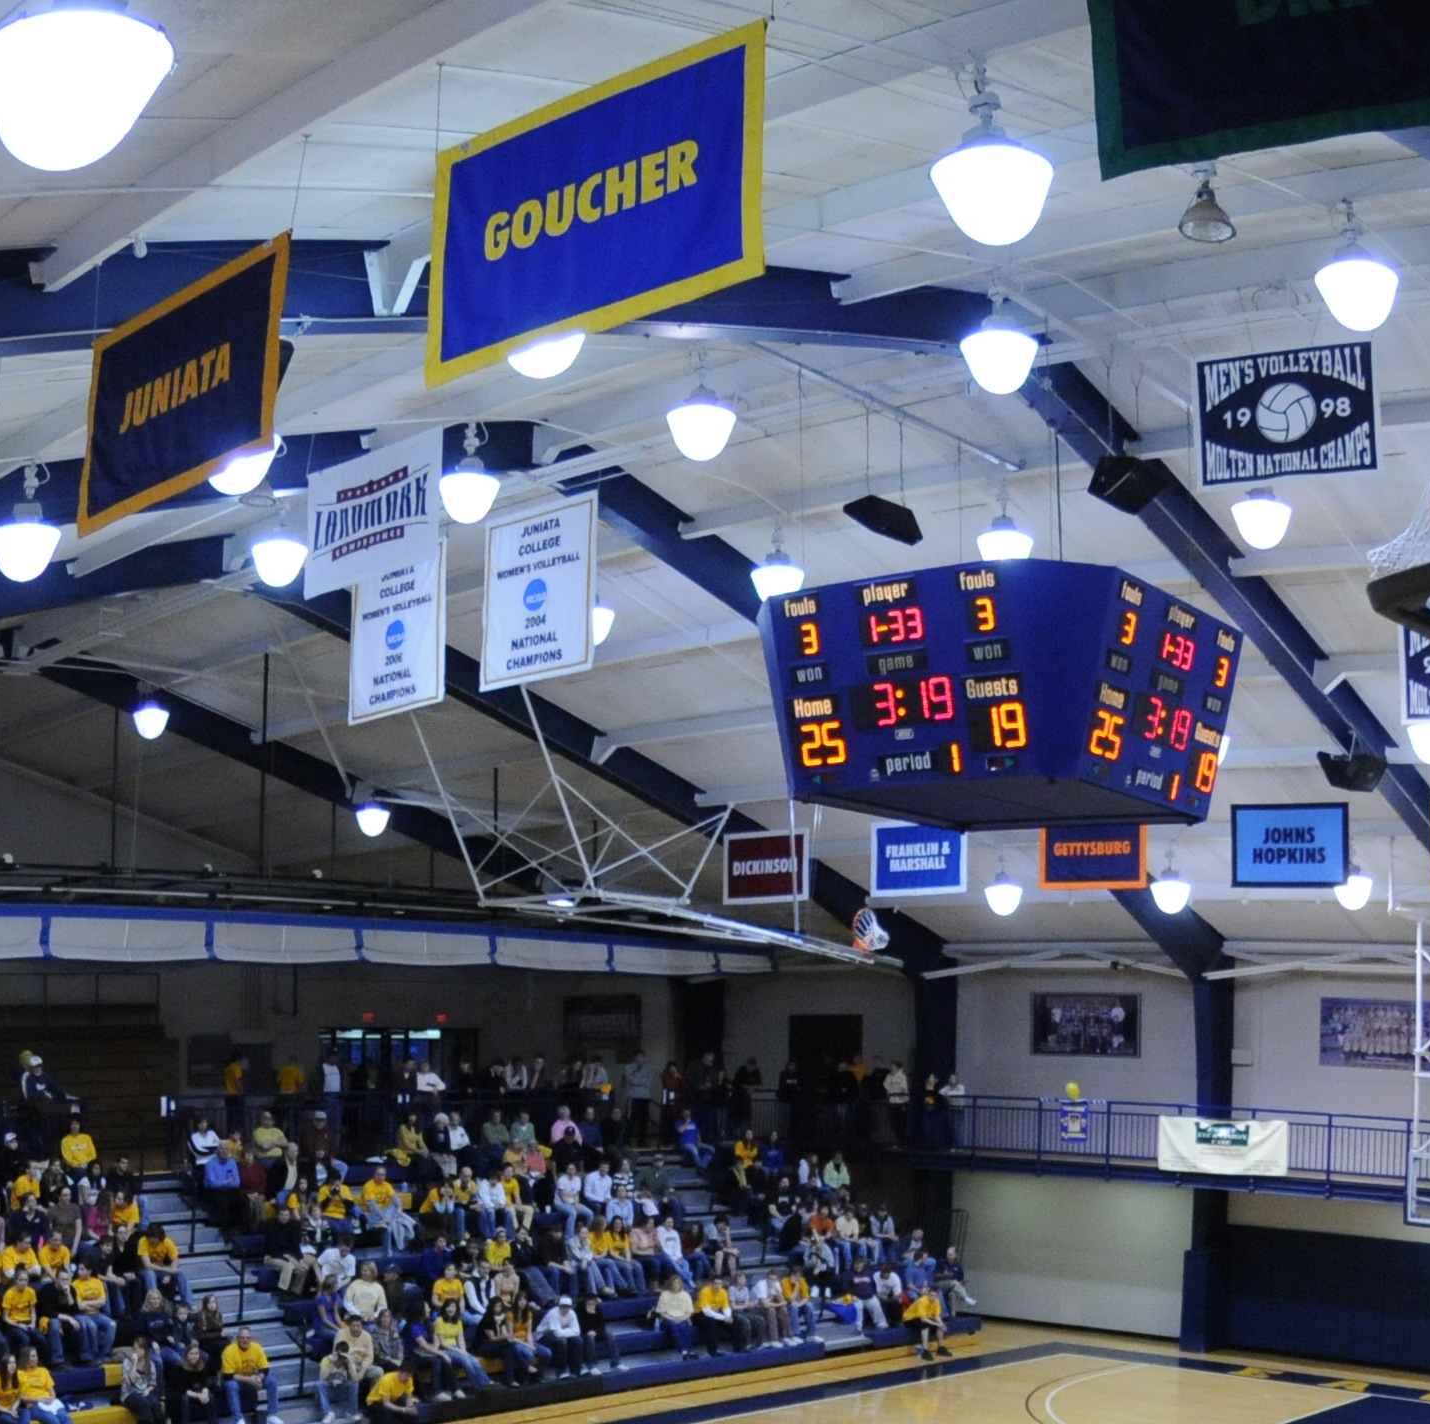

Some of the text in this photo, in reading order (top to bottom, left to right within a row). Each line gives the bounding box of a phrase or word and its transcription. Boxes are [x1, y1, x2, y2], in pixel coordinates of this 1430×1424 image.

[484, 139, 699, 262] GOUCHER
[119, 341, 231, 436] JUNIATA
[1203, 346, 1366, 413] MEN'S VOLLEYBALL
[1222, 396, 1352, 430] 19 98
[1205, 421, 1371, 482] MOLTEN NATIONAL CHAMPS
[314, 472, 429, 550] LANDMARK
[521, 517, 561, 538] JUNIATA
[518, 535, 561, 557] COLLEGE
[497, 551, 580, 581] WOMEN'S VOLLEYBALL
[379, 580, 415, 600] COLLEGE
[784, 570, 995, 618] fouls player fouls
[1121, 580, 1143, 607] fouls
[1167, 605, 1196, 630] player
[525, 613, 547, 630] 2004
[801, 622, 819, 655] 3
[976, 597, 996, 631] 3
[511, 631, 558, 650] NATIONAL
[1121, 611, 1138, 645] 3
[1215, 657, 1230, 688] 3
[506, 648, 563, 671] CHAMPIONS
[796, 643, 1002, 683] won game won
[373, 669, 412, 686] NATIONAL
[369, 684, 417, 706] CHAMPIONS
[794, 698, 833, 718] Home
[965, 677, 1018, 699] Guests
[1099, 682, 1125, 710] Home
[800, 702, 1028, 767] 25 19
[885, 752, 931, 776] period
[949, 743, 962, 773] 1
[1089, 709, 1218, 793] 25 19
[1169, 773, 1181, 801] 1
[885, 842, 951, 858] FRANKLIN &
[1053, 840, 1131, 857] GETTYSBURG
[1262, 826, 1315, 846] JOHNS
[732, 856, 797, 877] DICKINSON
[890, 855, 946, 873] MARSHALL
[1252, 845, 1326, 865] HOPKINS
